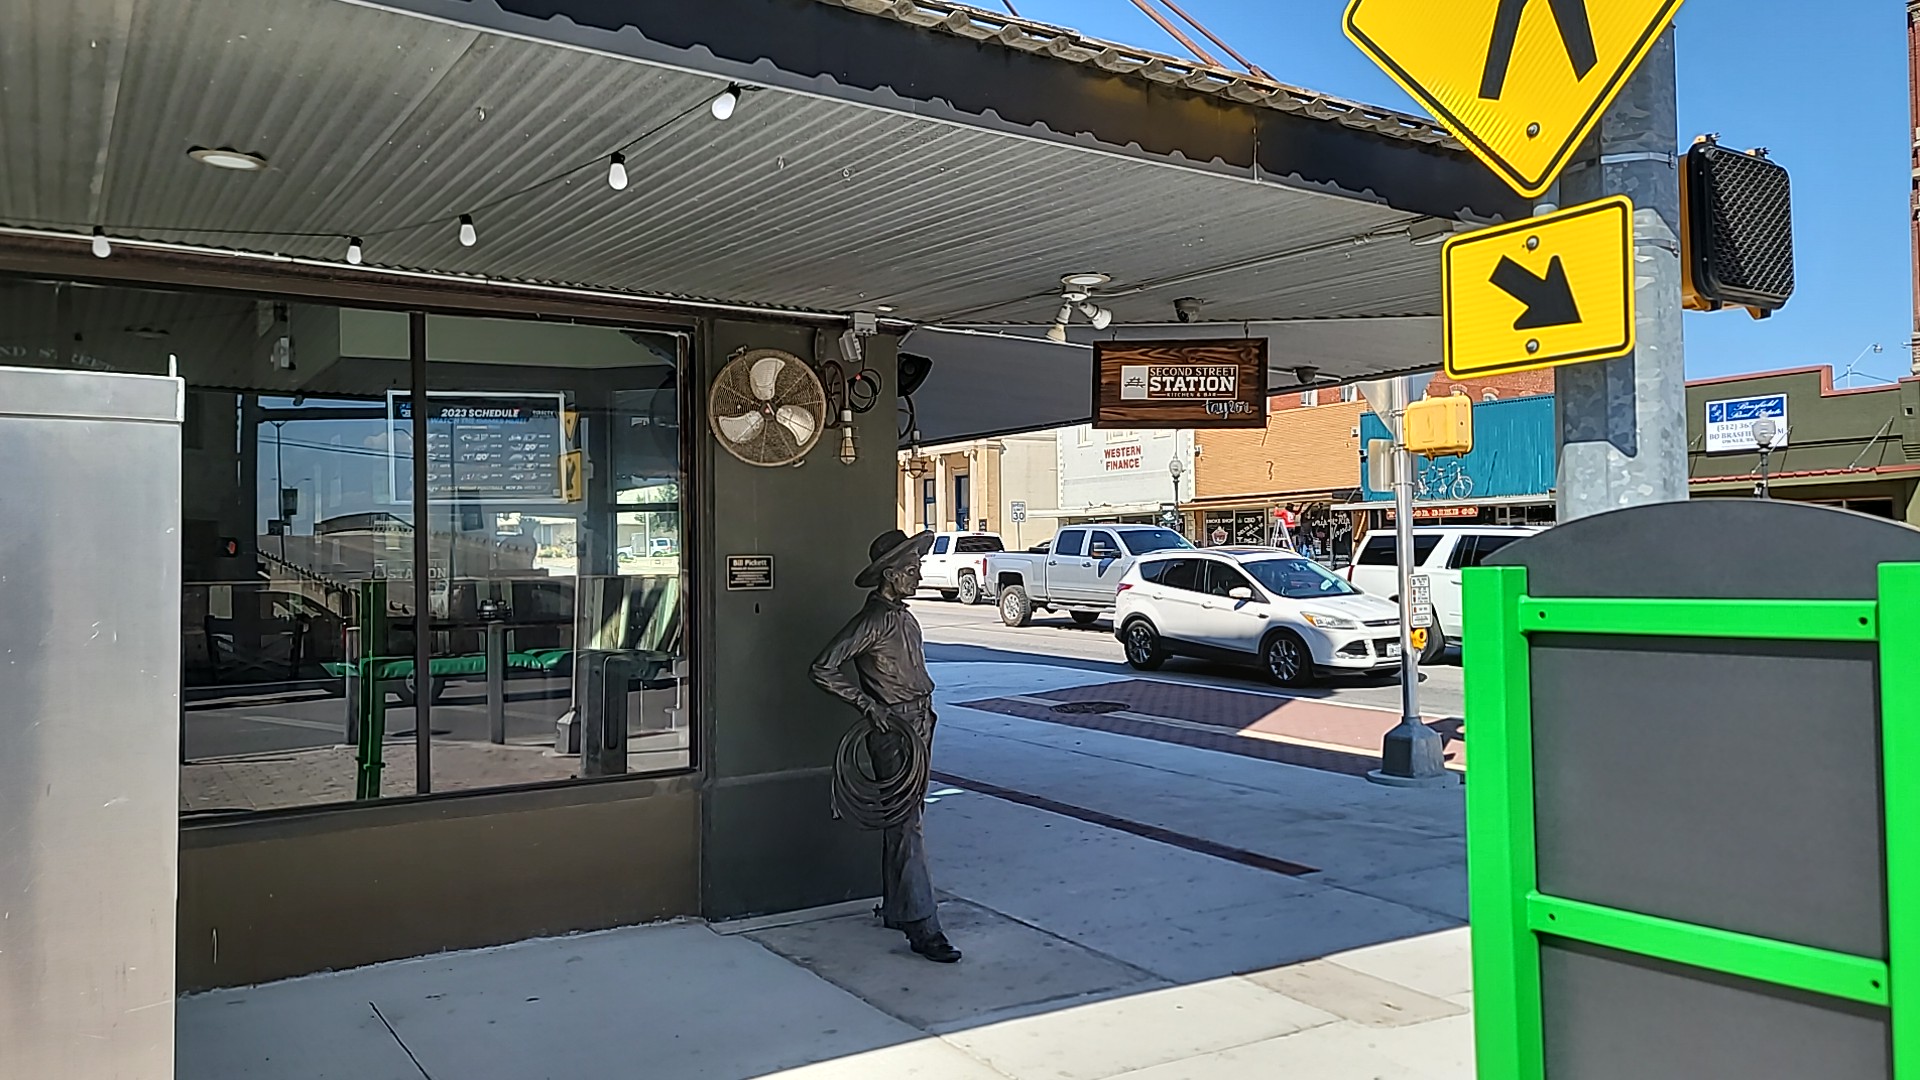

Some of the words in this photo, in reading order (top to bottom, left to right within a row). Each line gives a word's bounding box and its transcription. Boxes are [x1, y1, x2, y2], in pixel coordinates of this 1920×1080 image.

[1150, 367, 1192, 377] SECOND
[1195, 367, 1235, 376] STREET
[1150, 376, 1235, 392] STATION
[440, 408, 467, 418] 2023
[468, 408, 520, 418] SCHEDULE
[1104, 445, 1142, 459] WESTERN
[1105, 458, 1140, 471] FINANCE
[1012, 511, 1025, 520] 30
[1432, 508, 1459, 516] BIKE
[733, 559, 744, 567] Bill
